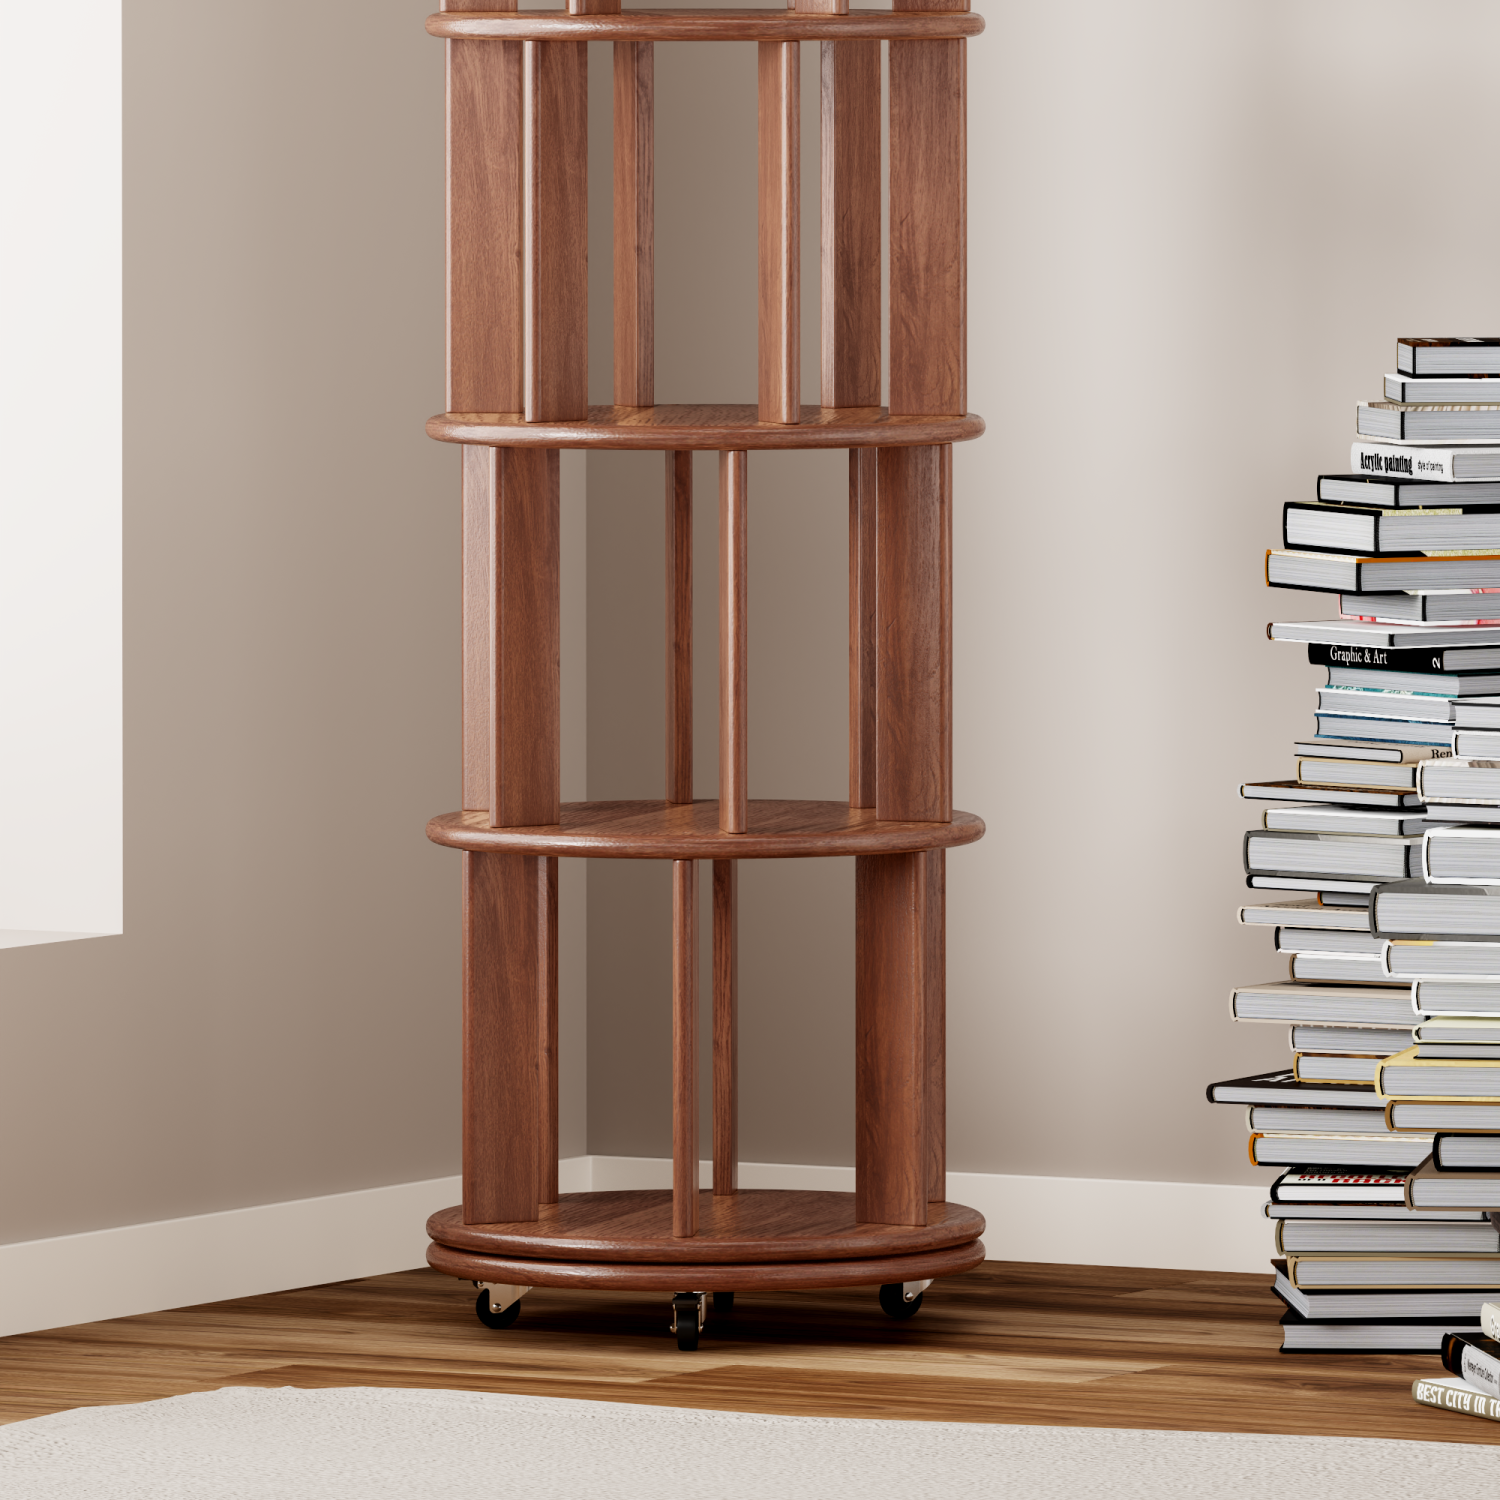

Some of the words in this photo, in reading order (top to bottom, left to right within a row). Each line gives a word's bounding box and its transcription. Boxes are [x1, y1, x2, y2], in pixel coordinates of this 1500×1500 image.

[1360, 452, 1383, 472] Acrylic
[1384, 454, 1413, 476] painting
[1330, 646, 1362, 666] Graphic
[1364, 648, 1371, 664] &
[1373, 649, 1387, 665] Art
[1417, 1382, 1444, 1405] BEST
[1445, 1389, 1472, 1411] CITY
[1474, 1395, 1485, 1415] IN
